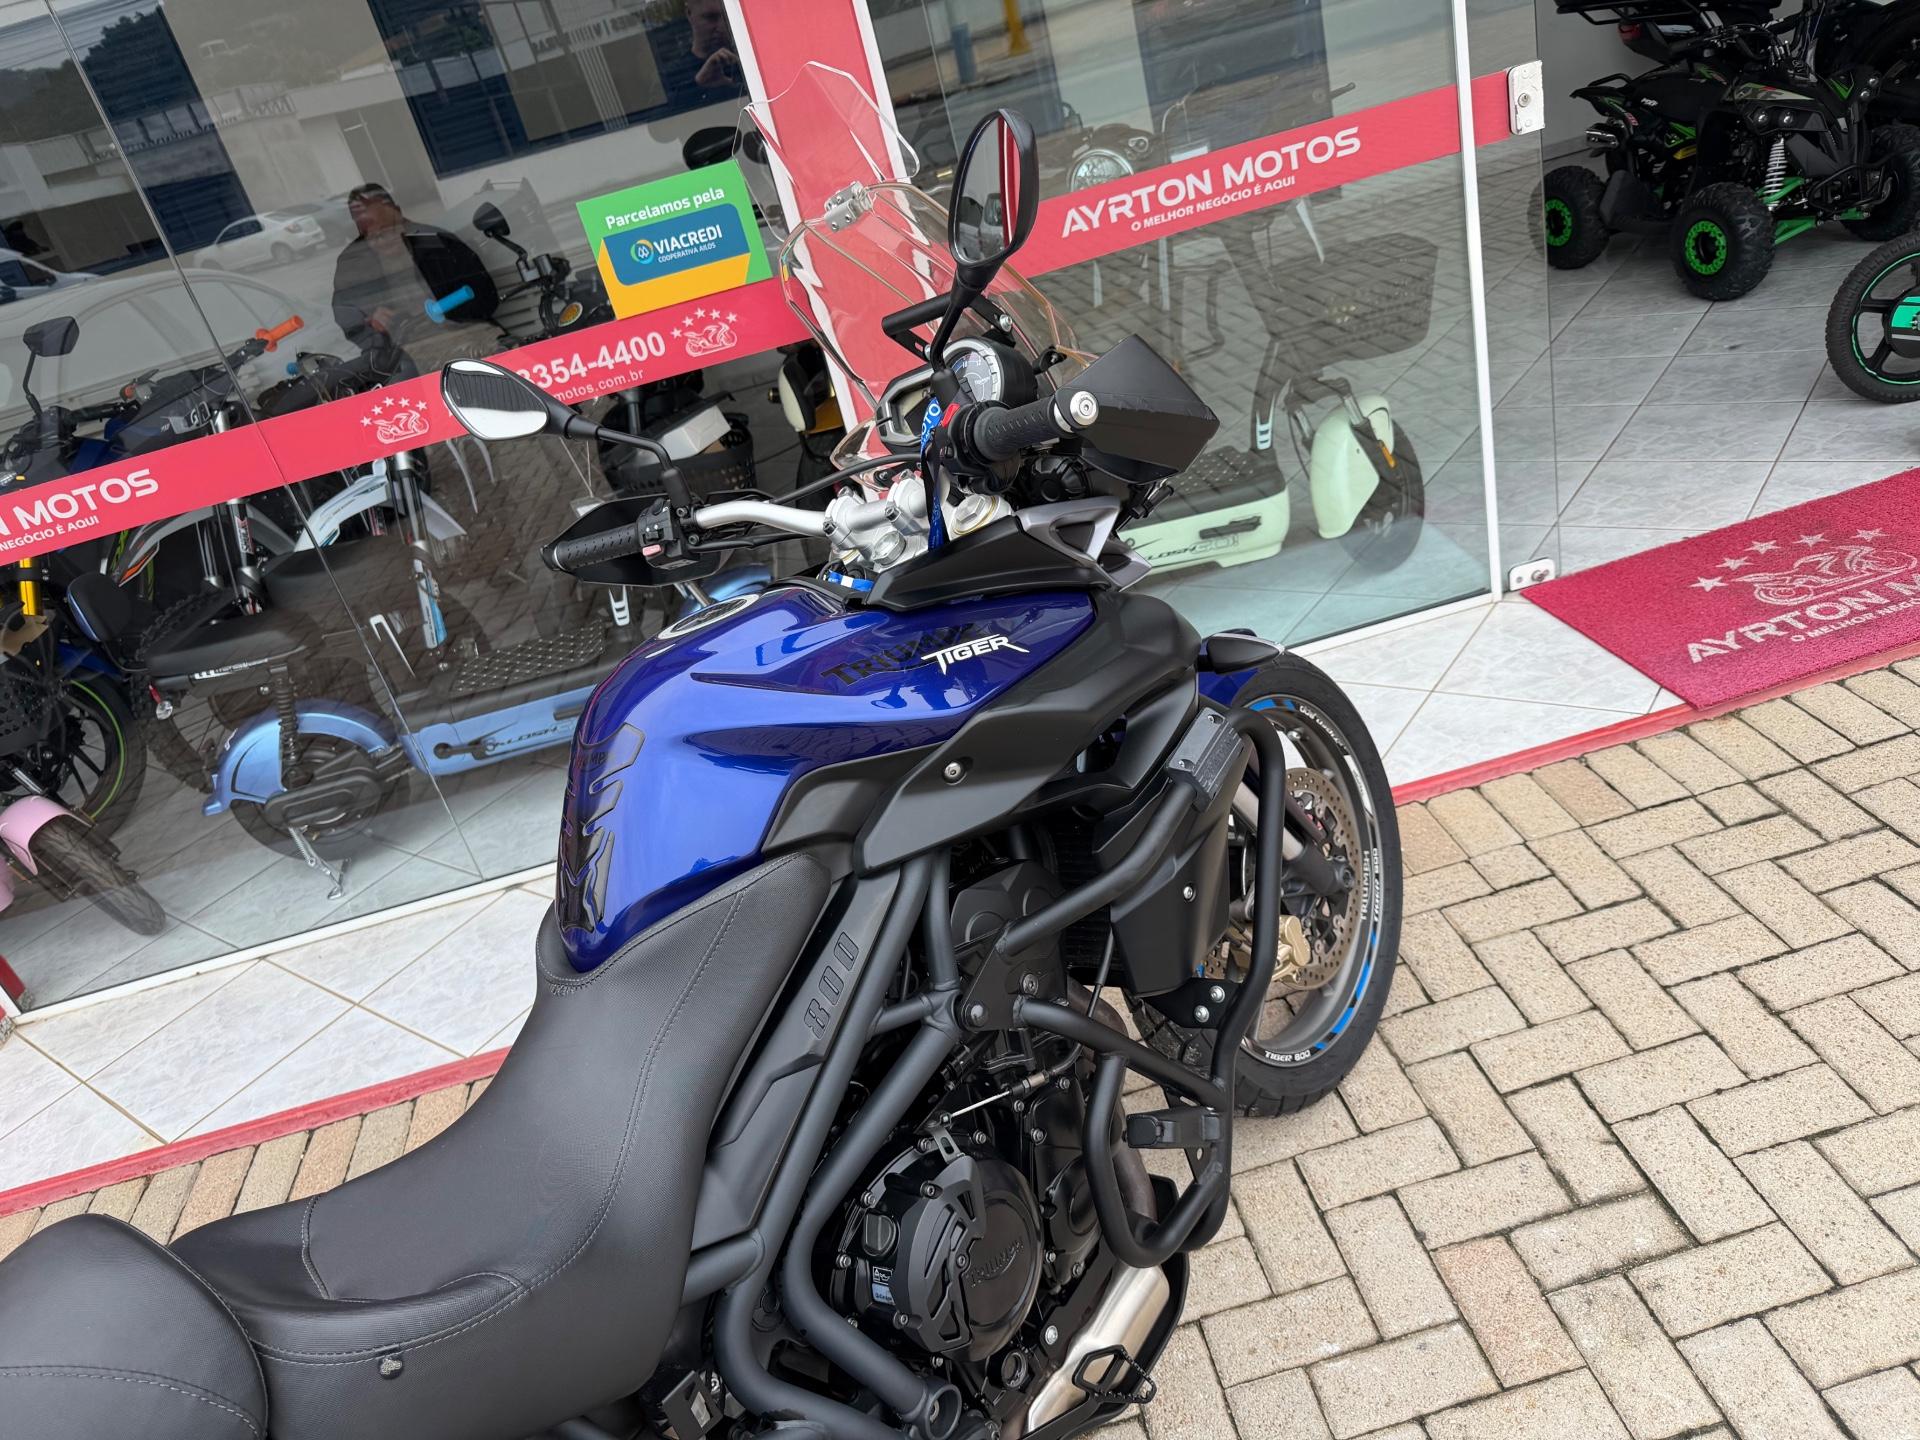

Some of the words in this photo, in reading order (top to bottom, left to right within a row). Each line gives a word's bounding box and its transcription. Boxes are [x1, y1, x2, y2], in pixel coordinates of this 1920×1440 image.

[1061, 168, 1213, 238] AYRTON
[1222, 126, 1361, 189] MOTOS
[1131, 221, 1142, 232] O
[1143, 206, 1194, 229] MELHOR
[1197, 188, 1252, 212] NEGÓCIO
[1254, 184, 1263, 196] É
[1264, 175, 1296, 193] AQUI
[605, 196, 691, 230] Parcelamos
[693, 187, 725, 208] pela
[653, 224, 723, 254] VIACREDI
[658, 247, 699, 263] COOPERATIVA
[13, 468, 159, 530] MOTOS
[57, 524, 66, 535] É
[67, 515, 99, 532] AQUI
[1687, 589, 1890, 664] AYRTON
[1790, 634, 1806, 643] O
[1808, 612, 1876, 638] MELHOR
[921, 633, 1030, 676] TIGER
[803, 930, 860, 1040] 800
[1264, 1050, 1293, 1062] TIGER
[1294, 1049, 1311, 1062] 800
